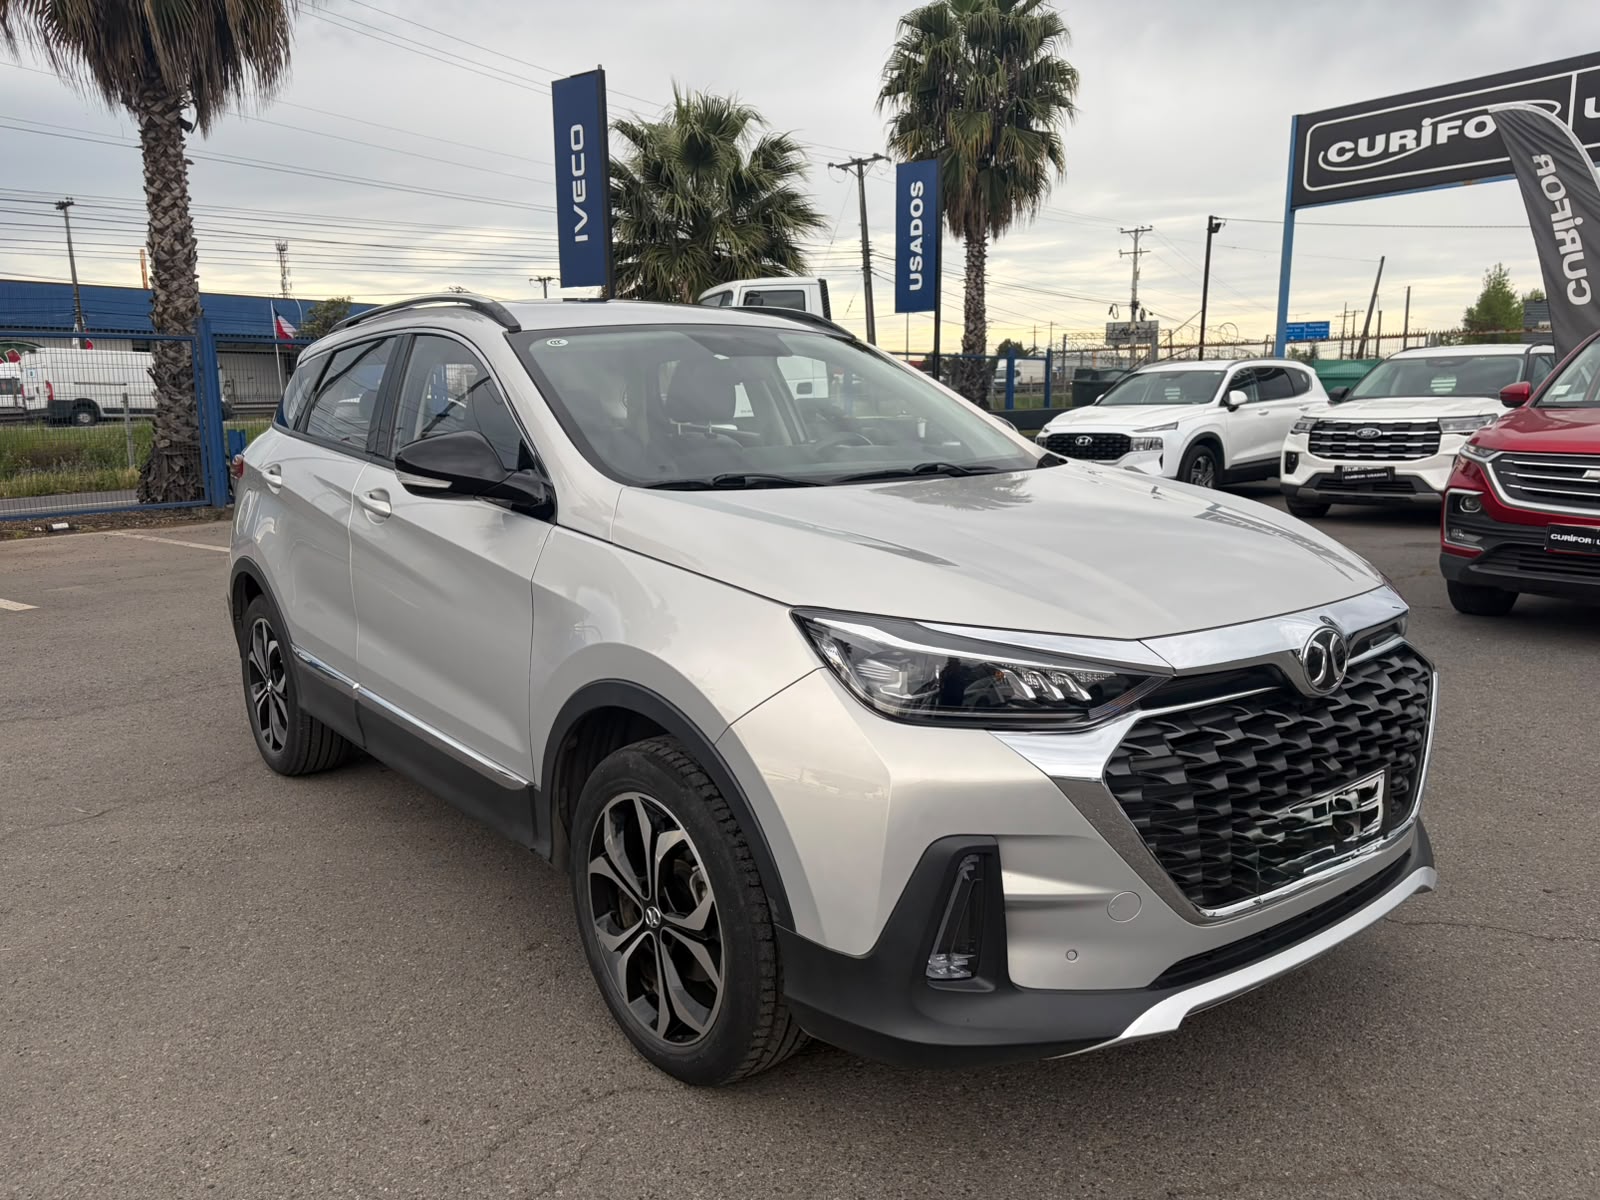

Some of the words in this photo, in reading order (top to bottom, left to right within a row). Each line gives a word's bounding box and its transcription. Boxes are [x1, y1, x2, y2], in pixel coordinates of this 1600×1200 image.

[570, 124, 588, 242] IVECO
[1327, 114, 1497, 163] CURiFO
[909, 180, 924, 291] USADOS
